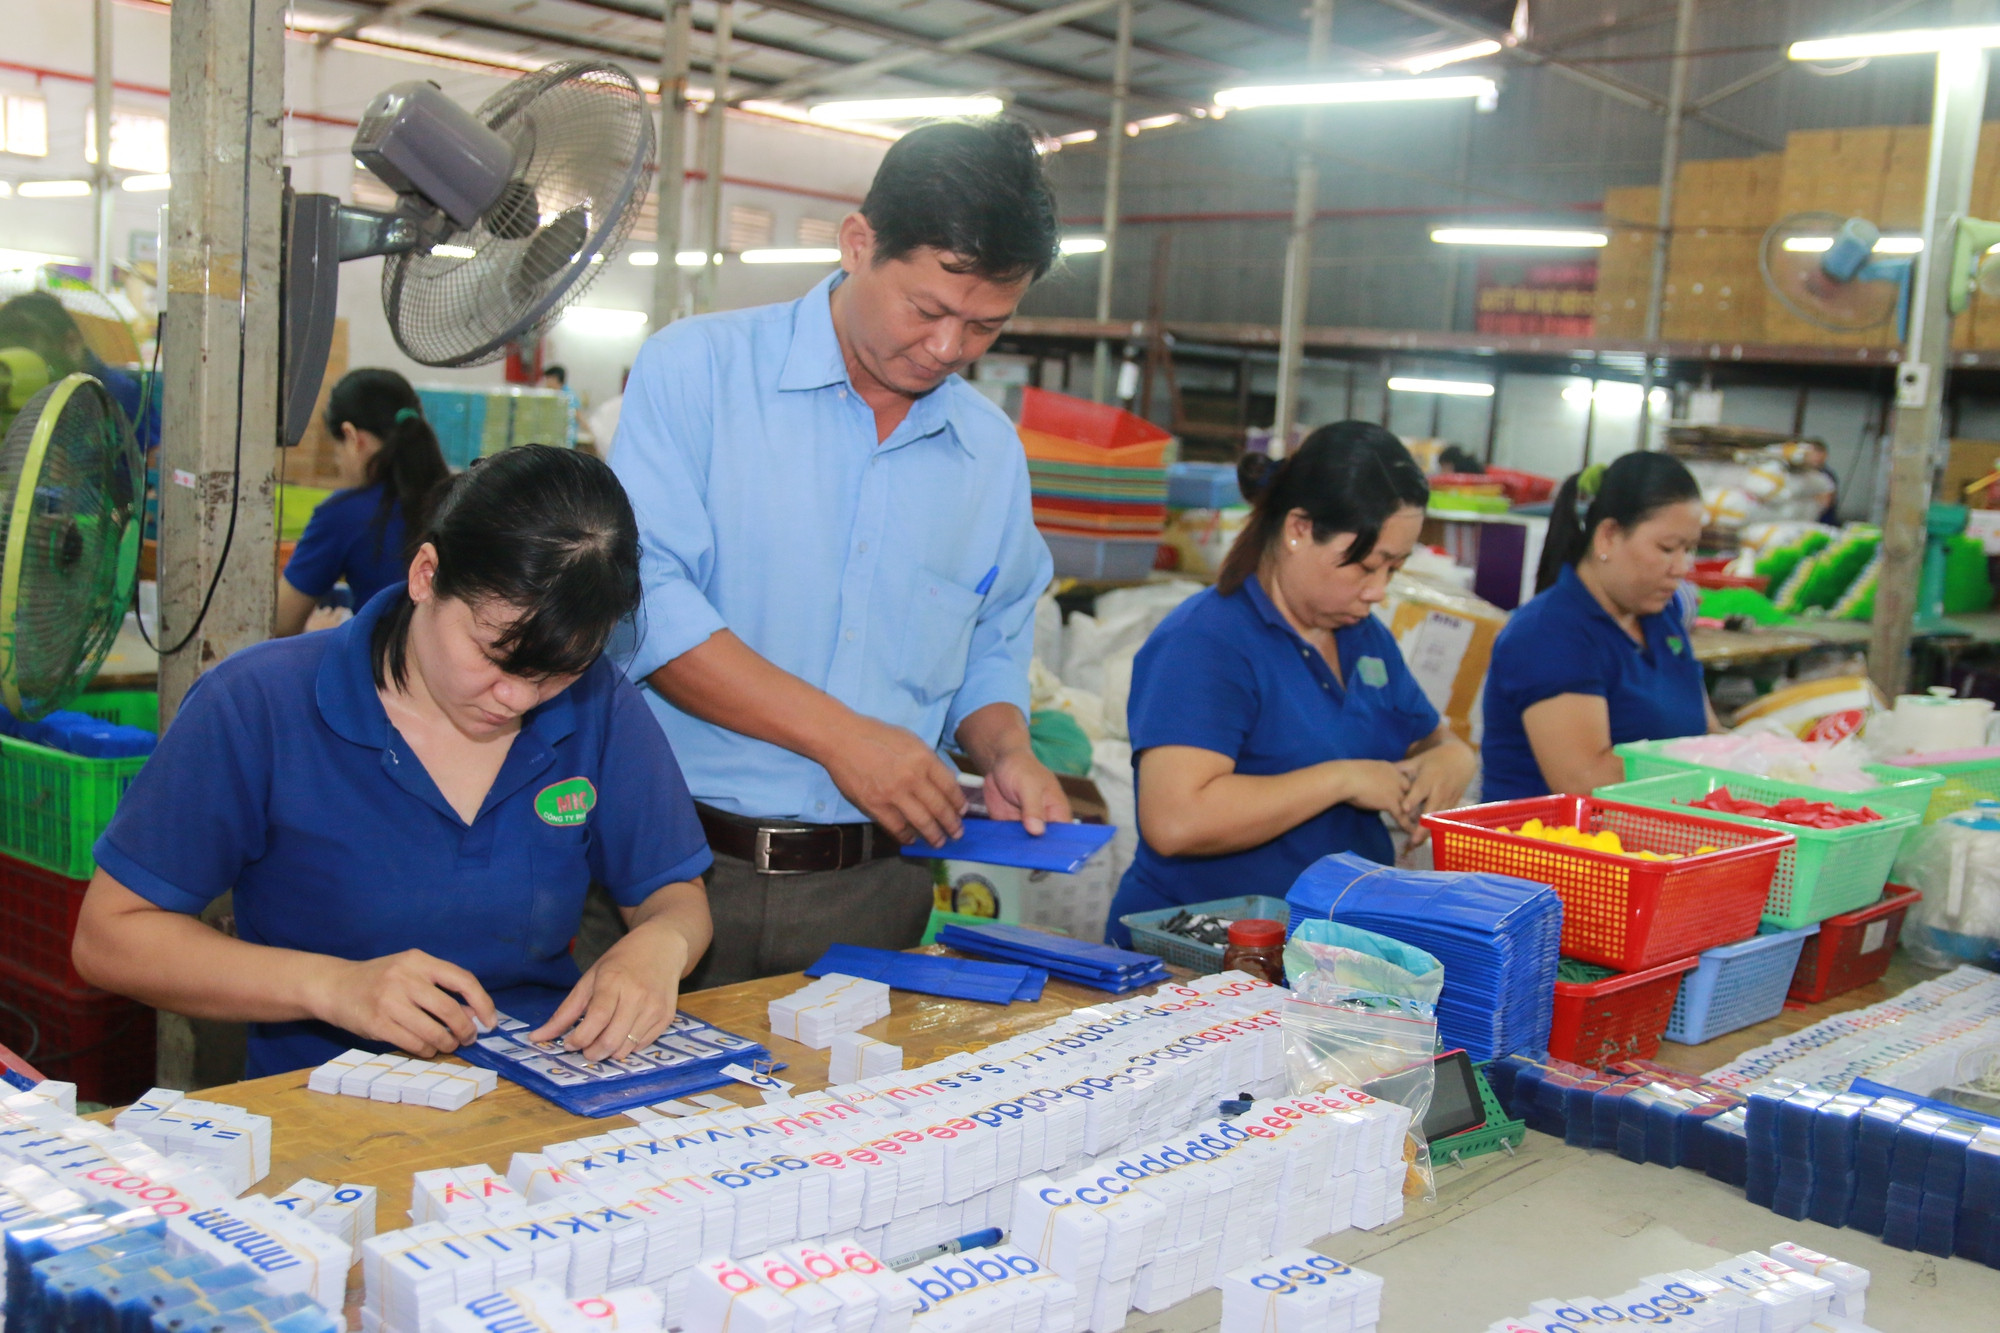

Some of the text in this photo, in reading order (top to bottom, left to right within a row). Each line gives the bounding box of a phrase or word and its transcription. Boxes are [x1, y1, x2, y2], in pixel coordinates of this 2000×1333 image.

[544, 812, 563, 822] CÔNG
[565, 814, 574, 822] TY
[546, 1067, 576, 1078] 5
[645, 1050, 676, 1061] 2
[1314, 1096, 1350, 1110] ê
[1340, 1088, 1376, 1104] ê
[602, 1148, 639, 1164] x
[634, 1142, 672, 1156] x
[706, 1129, 736, 1142] v
[743, 1126, 772, 1138] v
[936, 1078, 962, 1088] s
[957, 1072, 984, 1083] s
[979, 1064, 1006, 1074] s
[1272, 1106, 1304, 1120] e
[1290, 1099, 1327, 1114] ê
[1245, 1125, 1276, 1139] e
[1262, 1116, 1293, 1130] e
[1140, 1153, 1172, 1173] d
[1160, 1145, 1195, 1166] d
[1115, 1160, 1152, 1180] d
[1096, 1176, 1130, 1194] c
[1039, 1187, 1072, 1206] c
[1076, 1187, 1109, 1205] c
[514, 1222, 559, 1241] k
[553, 1216, 601, 1234] k
[763, 1260, 808, 1290] â
[800, 1248, 845, 1279] â
[841, 1246, 887, 1276] â
[906, 1253, 1040, 1303] b b b b
